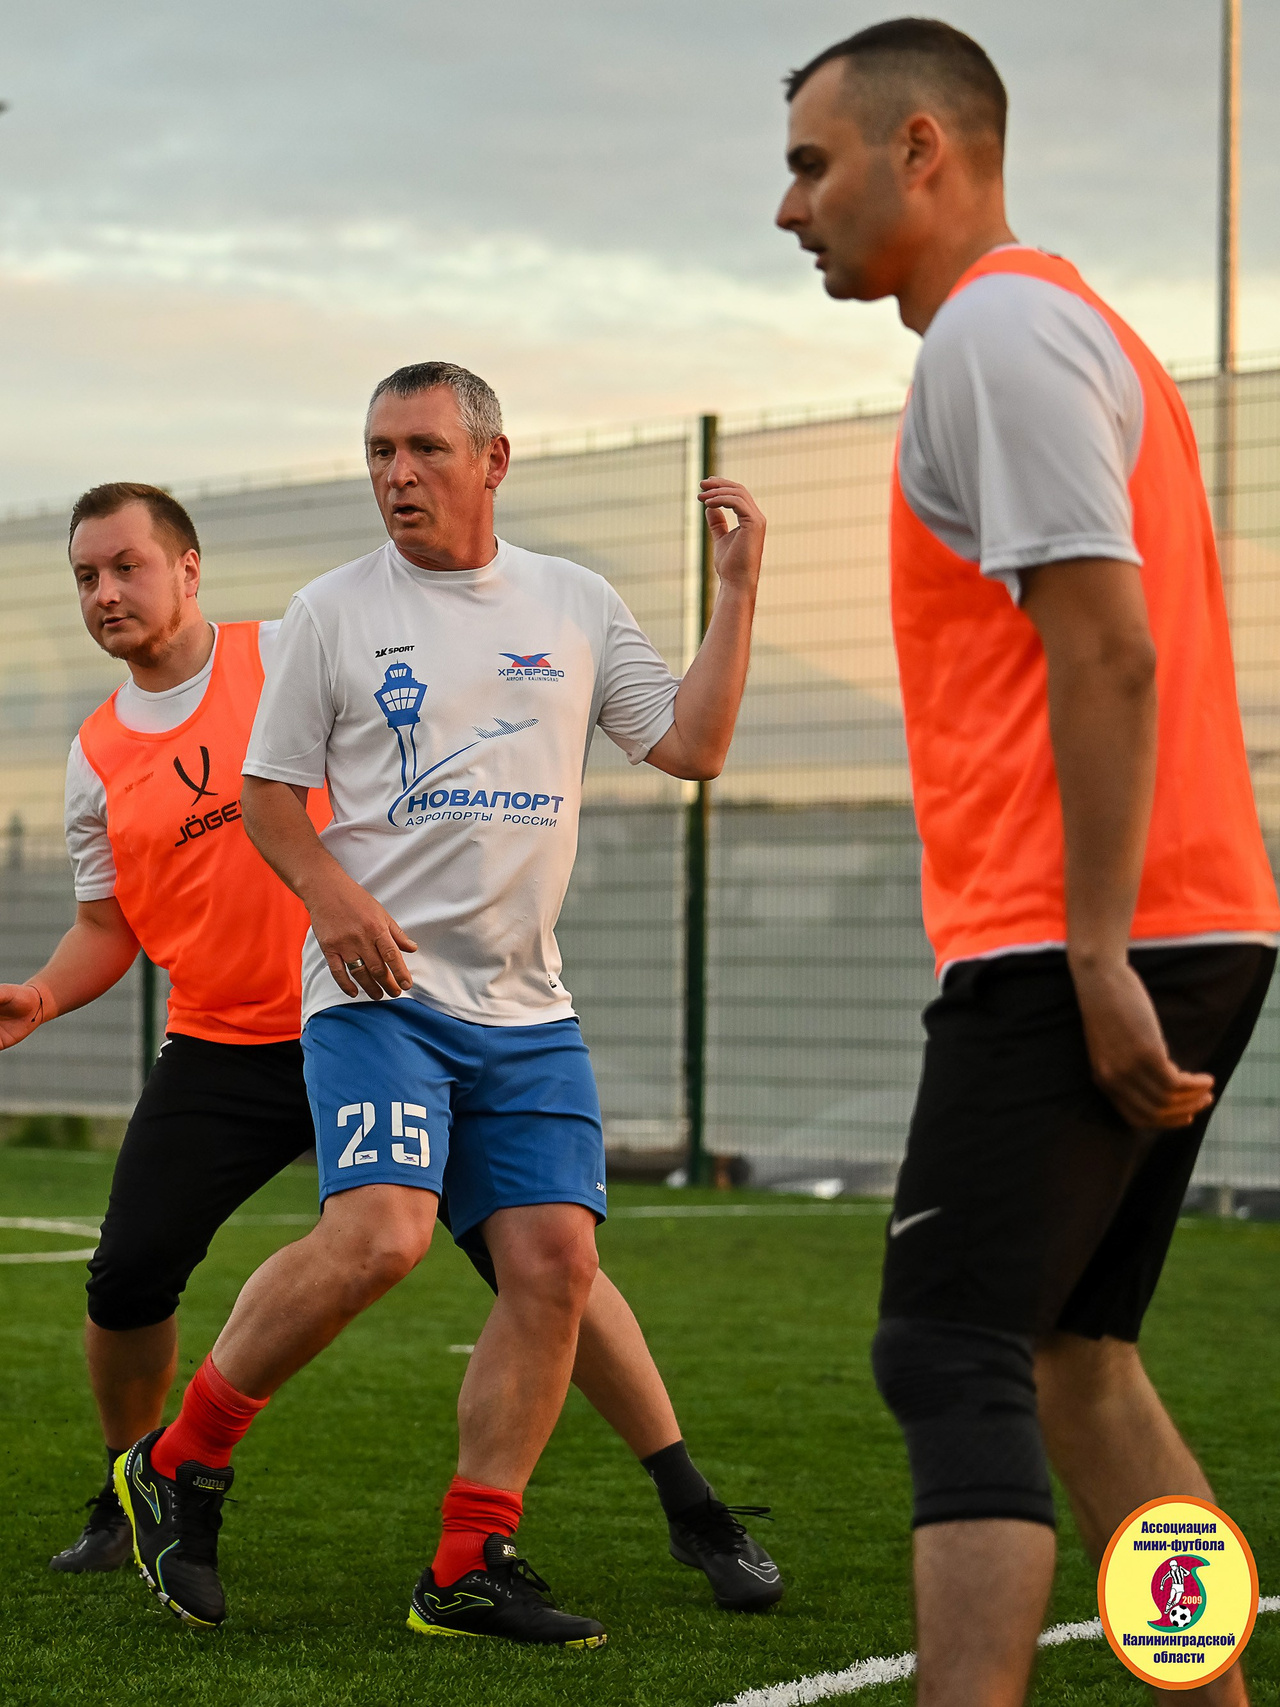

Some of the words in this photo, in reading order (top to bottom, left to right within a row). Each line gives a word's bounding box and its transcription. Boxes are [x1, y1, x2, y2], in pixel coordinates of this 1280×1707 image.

[375, 648, 387, 658] 2K
[388, 645, 415, 654] SPORT
[497, 668, 565, 678] ХРАБРОВО
[407, 789, 564, 813] НОВАПОРТ
[174, 800, 242, 847] JÖGE
[405, 811, 493, 827] АЭРОПОРТЫ
[502, 814, 558, 828] РОССИИ
[337, 1101, 430, 1169] 25
